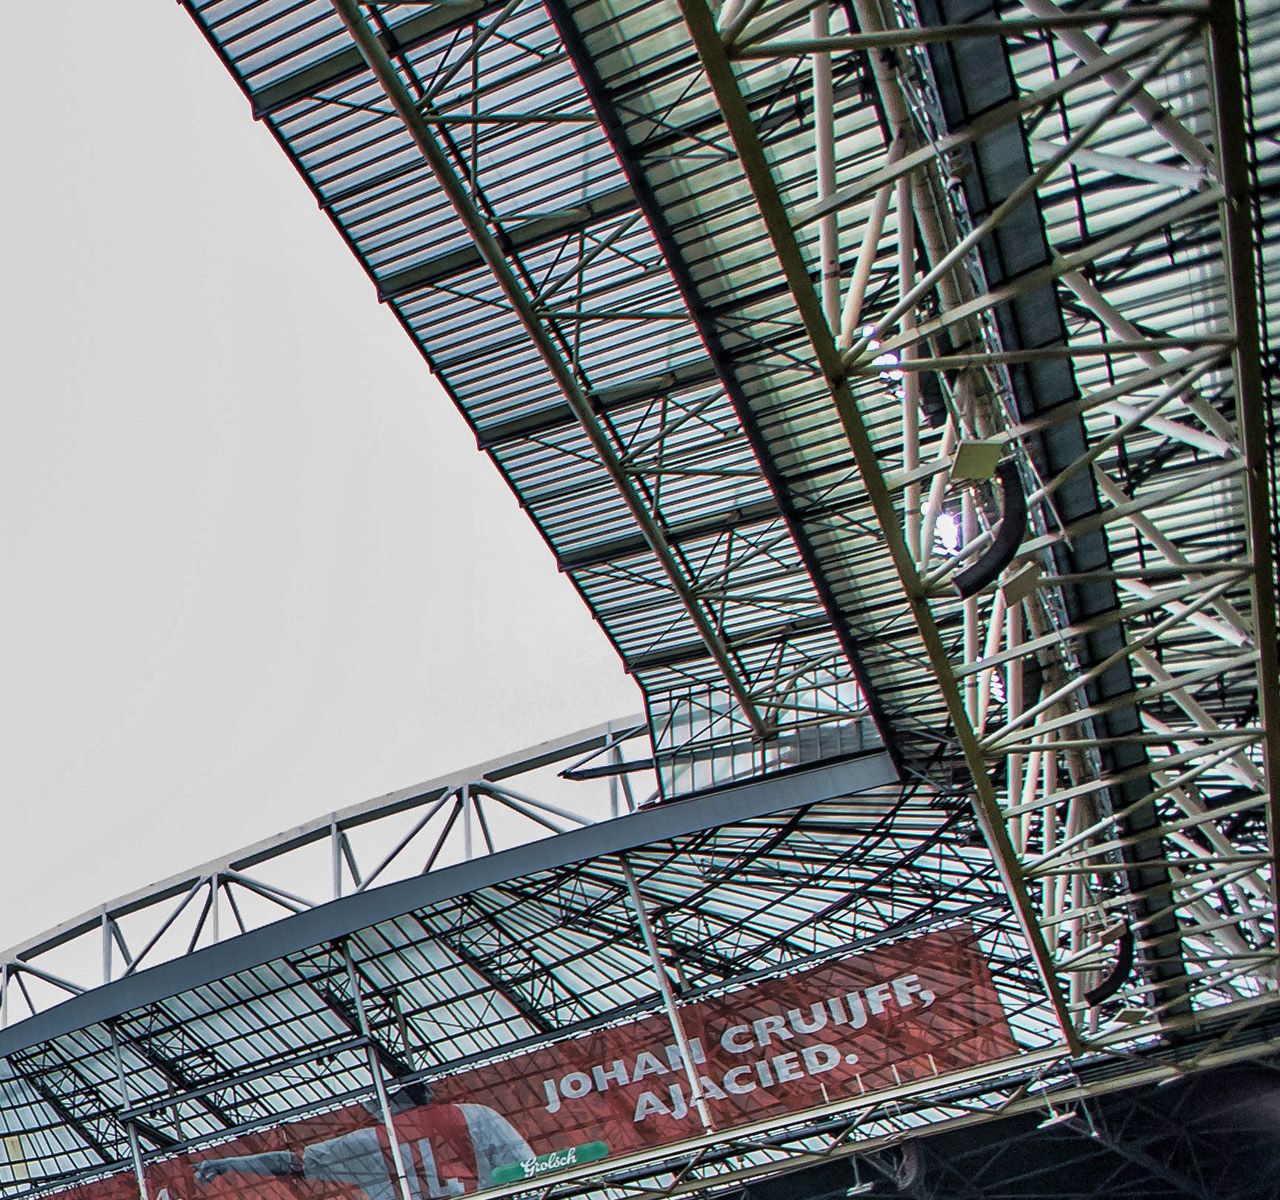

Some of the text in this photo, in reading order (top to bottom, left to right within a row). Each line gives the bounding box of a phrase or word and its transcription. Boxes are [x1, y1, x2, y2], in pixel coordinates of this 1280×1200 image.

[542, 973, 937, 1115] JOHAN CRUIJFF,
[633, 1042, 859, 1124] AJACIED.
[520, 1147, 577, 1178] Grolsch
